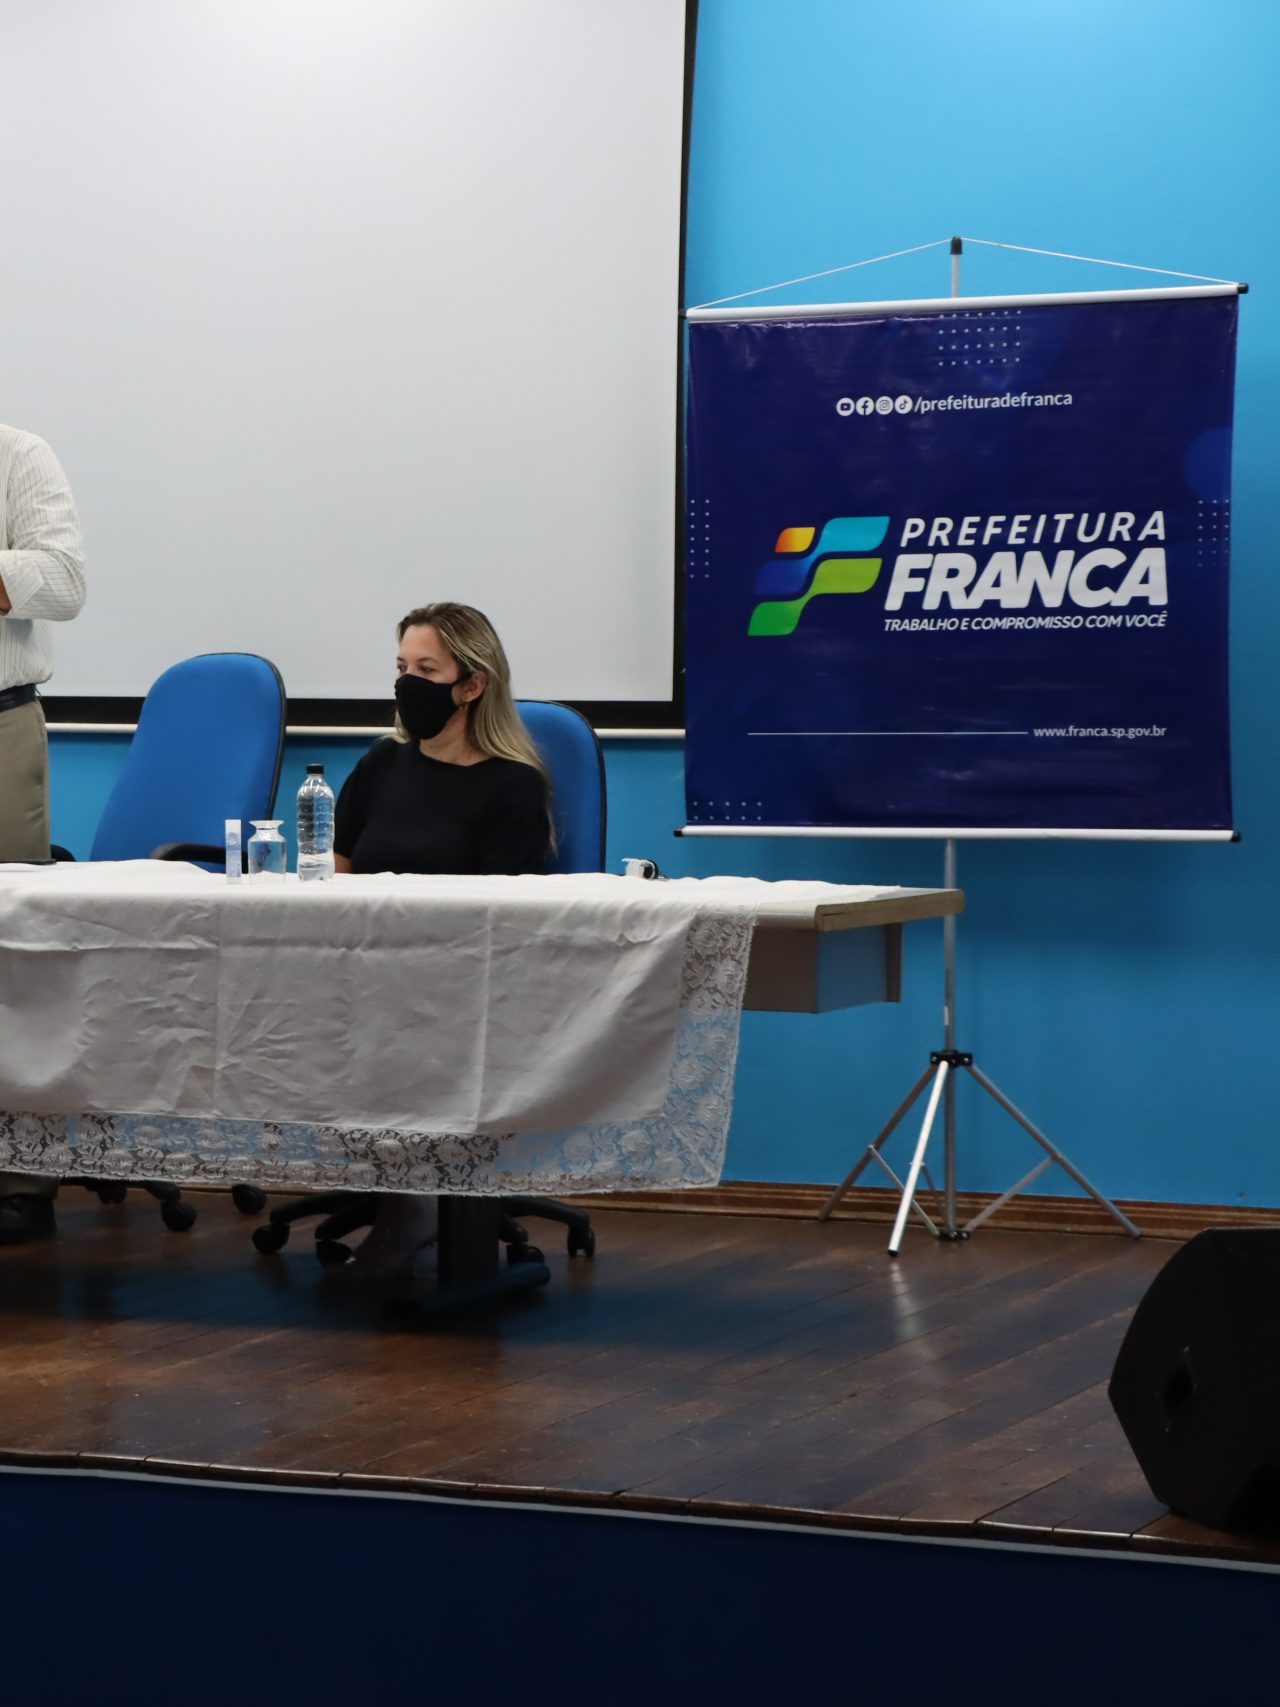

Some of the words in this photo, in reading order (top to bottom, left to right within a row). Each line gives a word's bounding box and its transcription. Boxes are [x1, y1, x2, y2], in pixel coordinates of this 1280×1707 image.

[913, 392, 1073, 414] /prefeituradefranca
[900, 510, 1166, 547] PREFEITURA
[883, 547, 1169, 611] FRANCA
[883, 618, 959, 632] TRABALHO
[960, 617, 970, 631] E
[971, 615, 1084, 631] COMPROMISSO
[1085, 614, 1123, 629] COM
[1125, 610, 1168, 628] VOCÊ
[1033, 725, 1167, 739] www.franca.sp.gov.br
